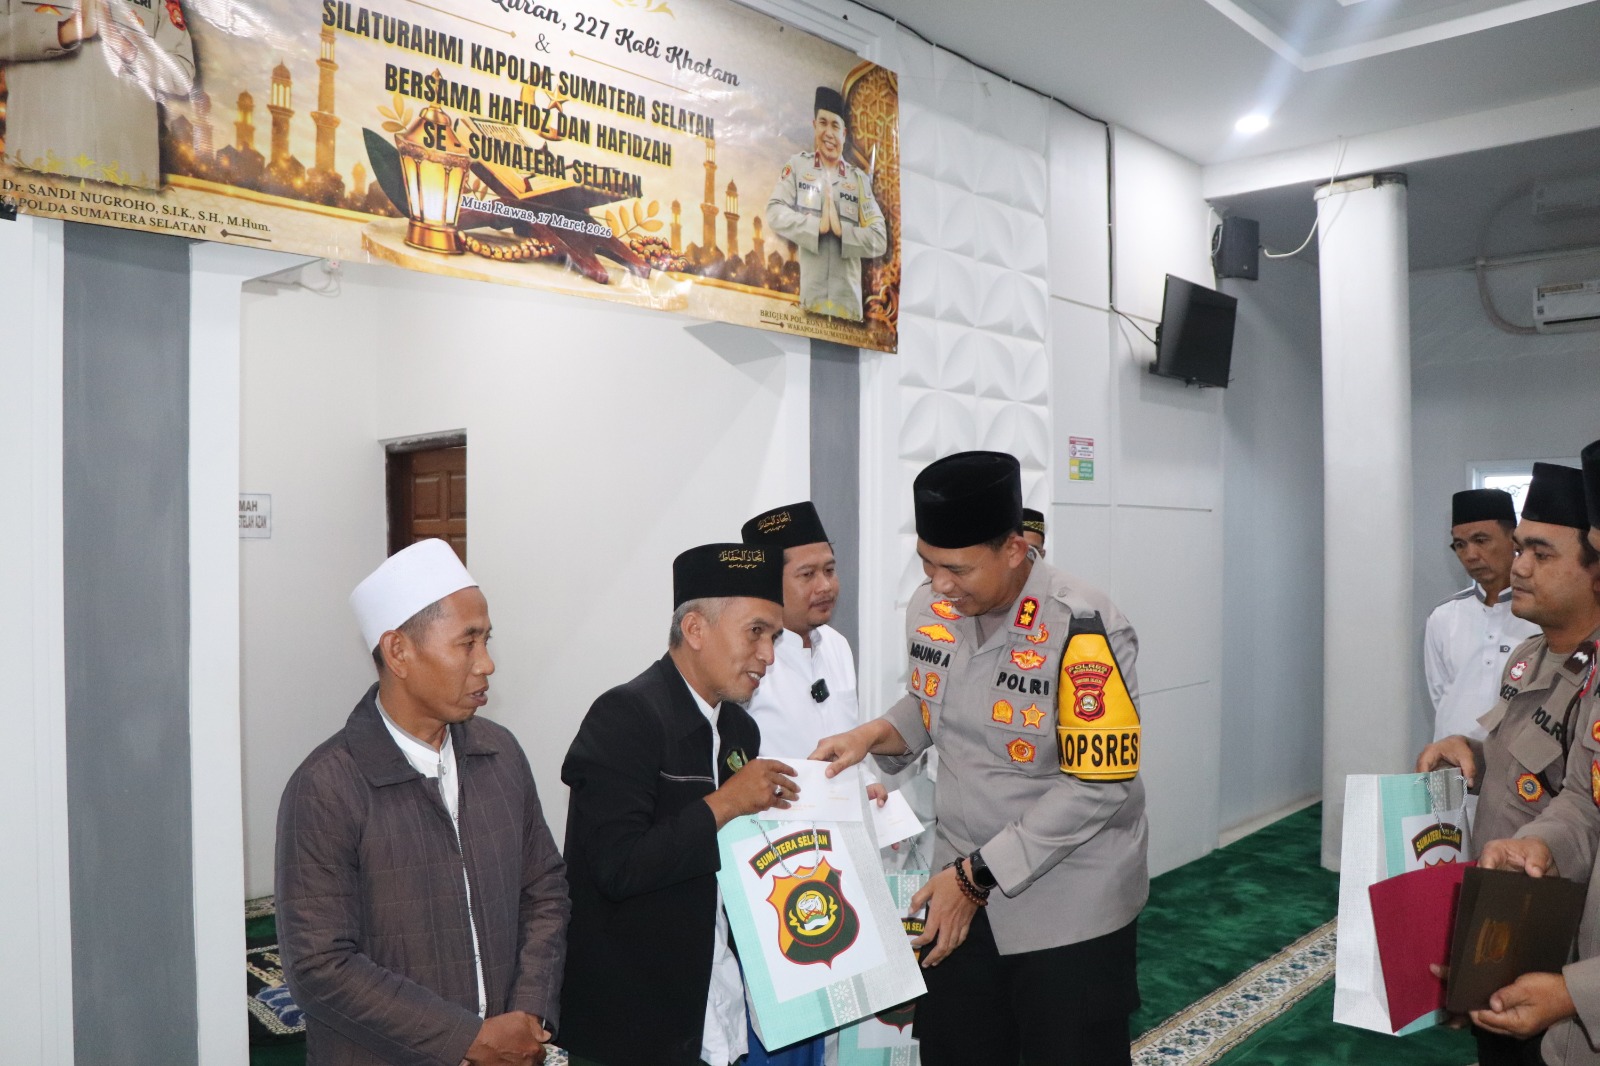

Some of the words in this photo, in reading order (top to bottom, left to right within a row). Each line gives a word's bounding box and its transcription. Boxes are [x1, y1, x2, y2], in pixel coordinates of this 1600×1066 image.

[491, 0, 567, 31] ur'an,
[573, 12, 610, 40] 227
[614, 28, 661, 59] Kali
[665, 46, 740, 87] Khatam
[534, 33, 551, 54] &
[322, 0, 464, 65] SILATURAHMI
[470, 42, 552, 92] KAPOLDA
[558, 71, 646, 120] SUMATERA
[651, 99, 715, 140] SELATAN
[384, 62, 481, 116] BERSAMA
[488, 92, 551, 134] HAFIDZ
[556, 112, 591, 145] DAN
[596, 123, 672, 167] HAFIDZAH
[423, 119, 447, 152] SE
[468, 132, 567, 181] SUMATERA
[572, 158, 643, 199] SELATAN
[2, 179, 24, 193] Dr.
[28, 183, 76, 201] SANDI
[80, 191, 159, 215] NUGROHO,
[161, 204, 196, 221] S.I.K.,
[198, 210, 224, 226] S.H.,
[227, 215, 271, 233] M.Hum.
[71, 205, 147, 226] SUMATERA
[149, 216, 207, 235] SELATAN
[460, 195, 493, 213] Musi
[493, 201, 537, 224] Rawas,
[538, 212, 551, 224] 17
[551, 213, 586, 232] Maret
[586, 222, 612, 239] 2026
[760, 309, 789, 322] BRIGJEN
[940, 653, 951, 668] A
[996, 671, 1050, 696] POLRI
[797, 834, 828, 848] SELAAN
